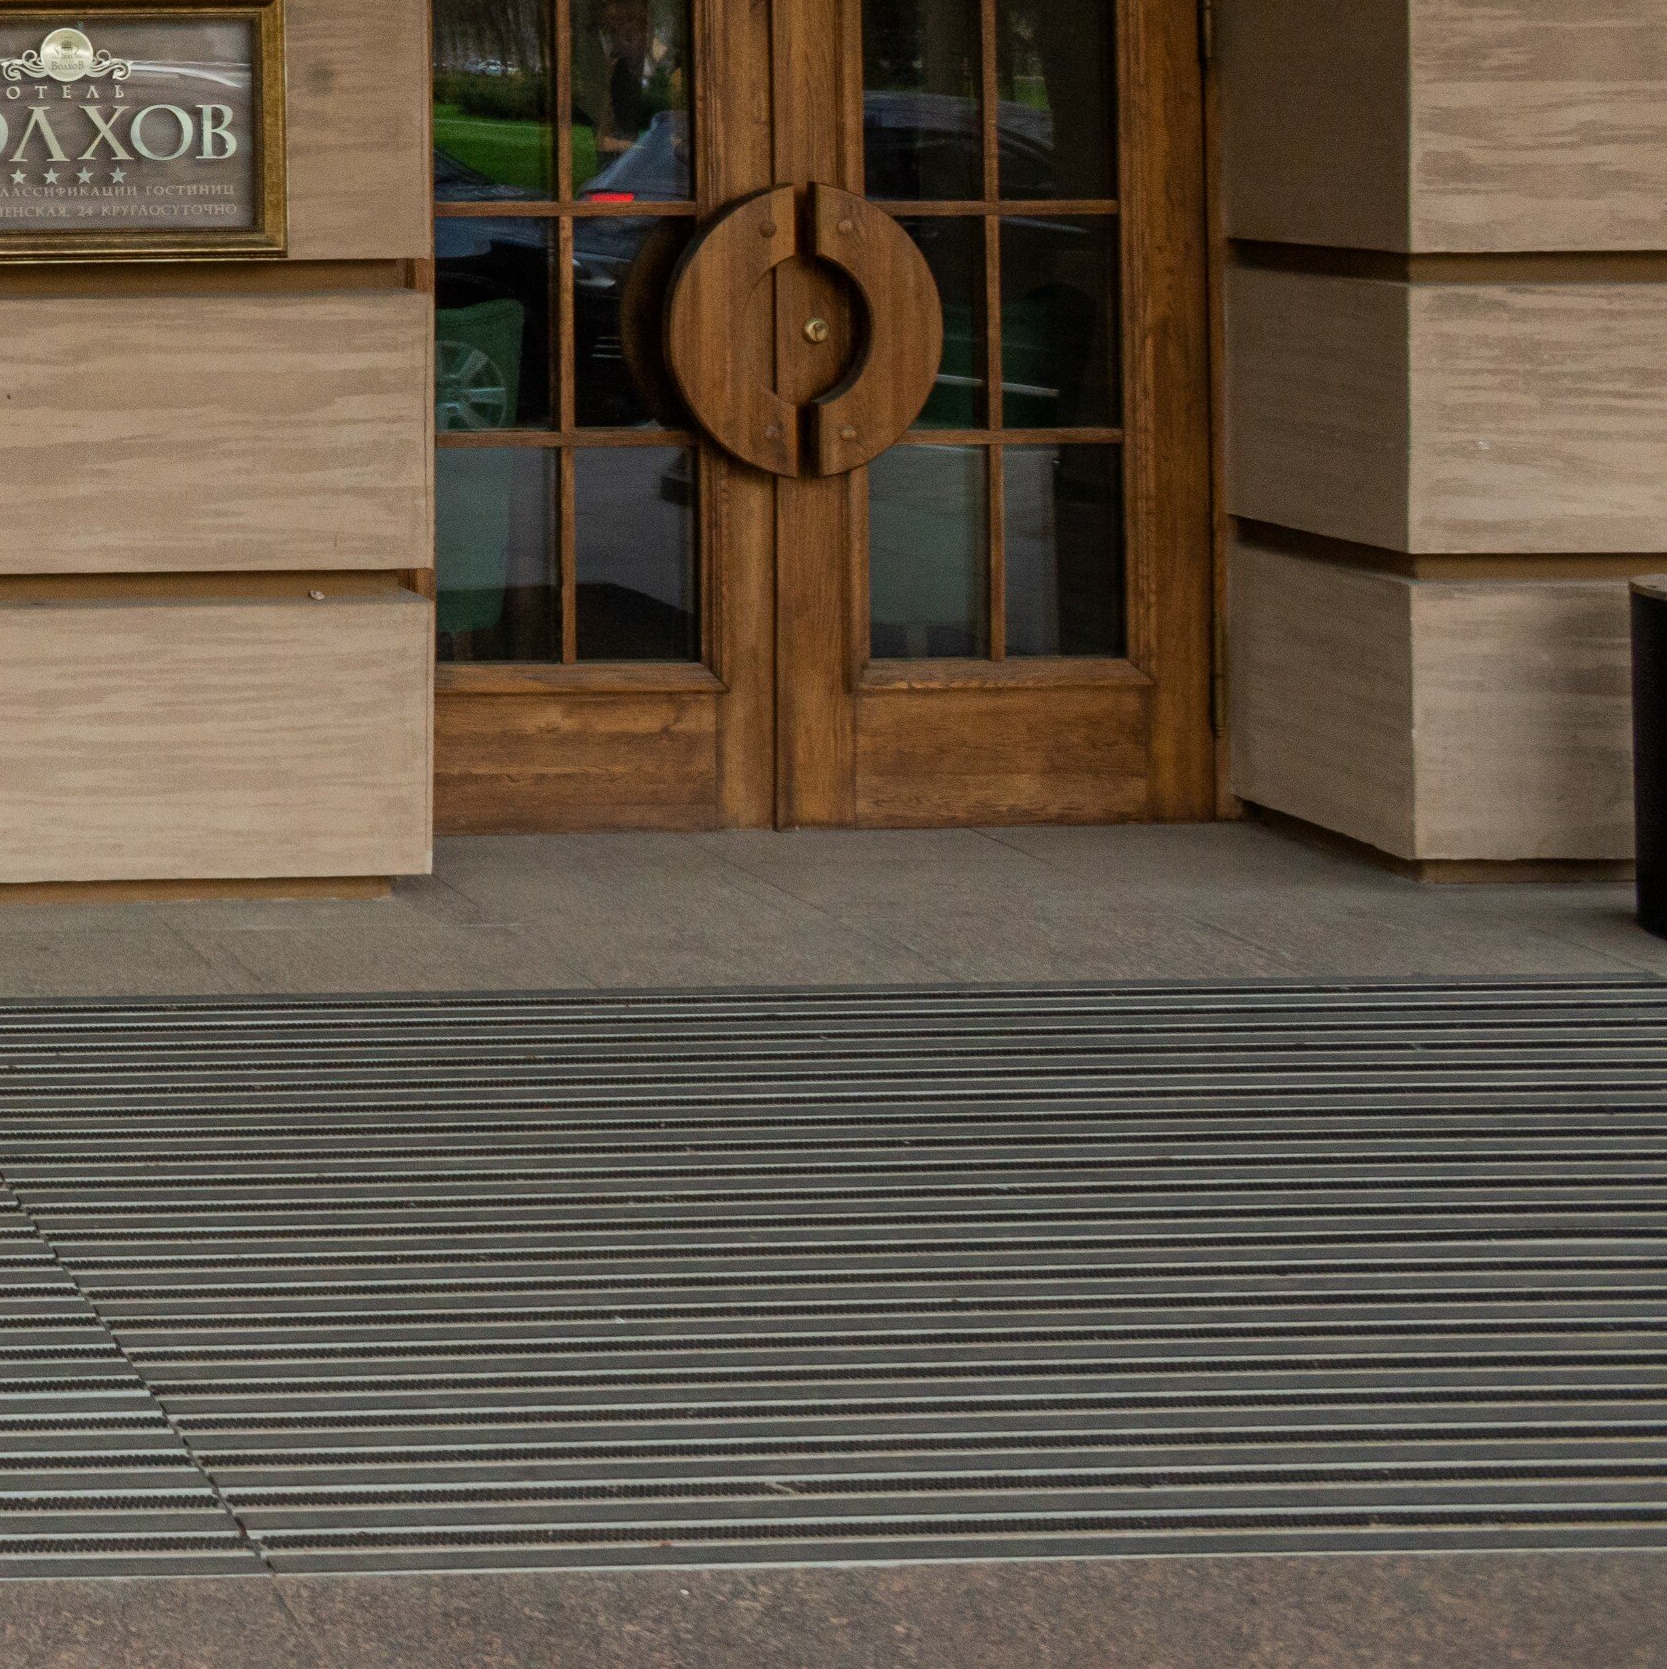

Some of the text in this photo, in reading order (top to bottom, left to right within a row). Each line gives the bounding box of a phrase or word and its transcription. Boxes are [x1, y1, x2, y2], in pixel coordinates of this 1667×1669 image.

[6, 84, 126, 99] ОТЕЛЬ
[145, 184, 235, 198] ГОСТИНИЦ
[76, 205, 93, 217] 24
[101, 203, 238, 217] КРУГЛОСУТОЧНО
